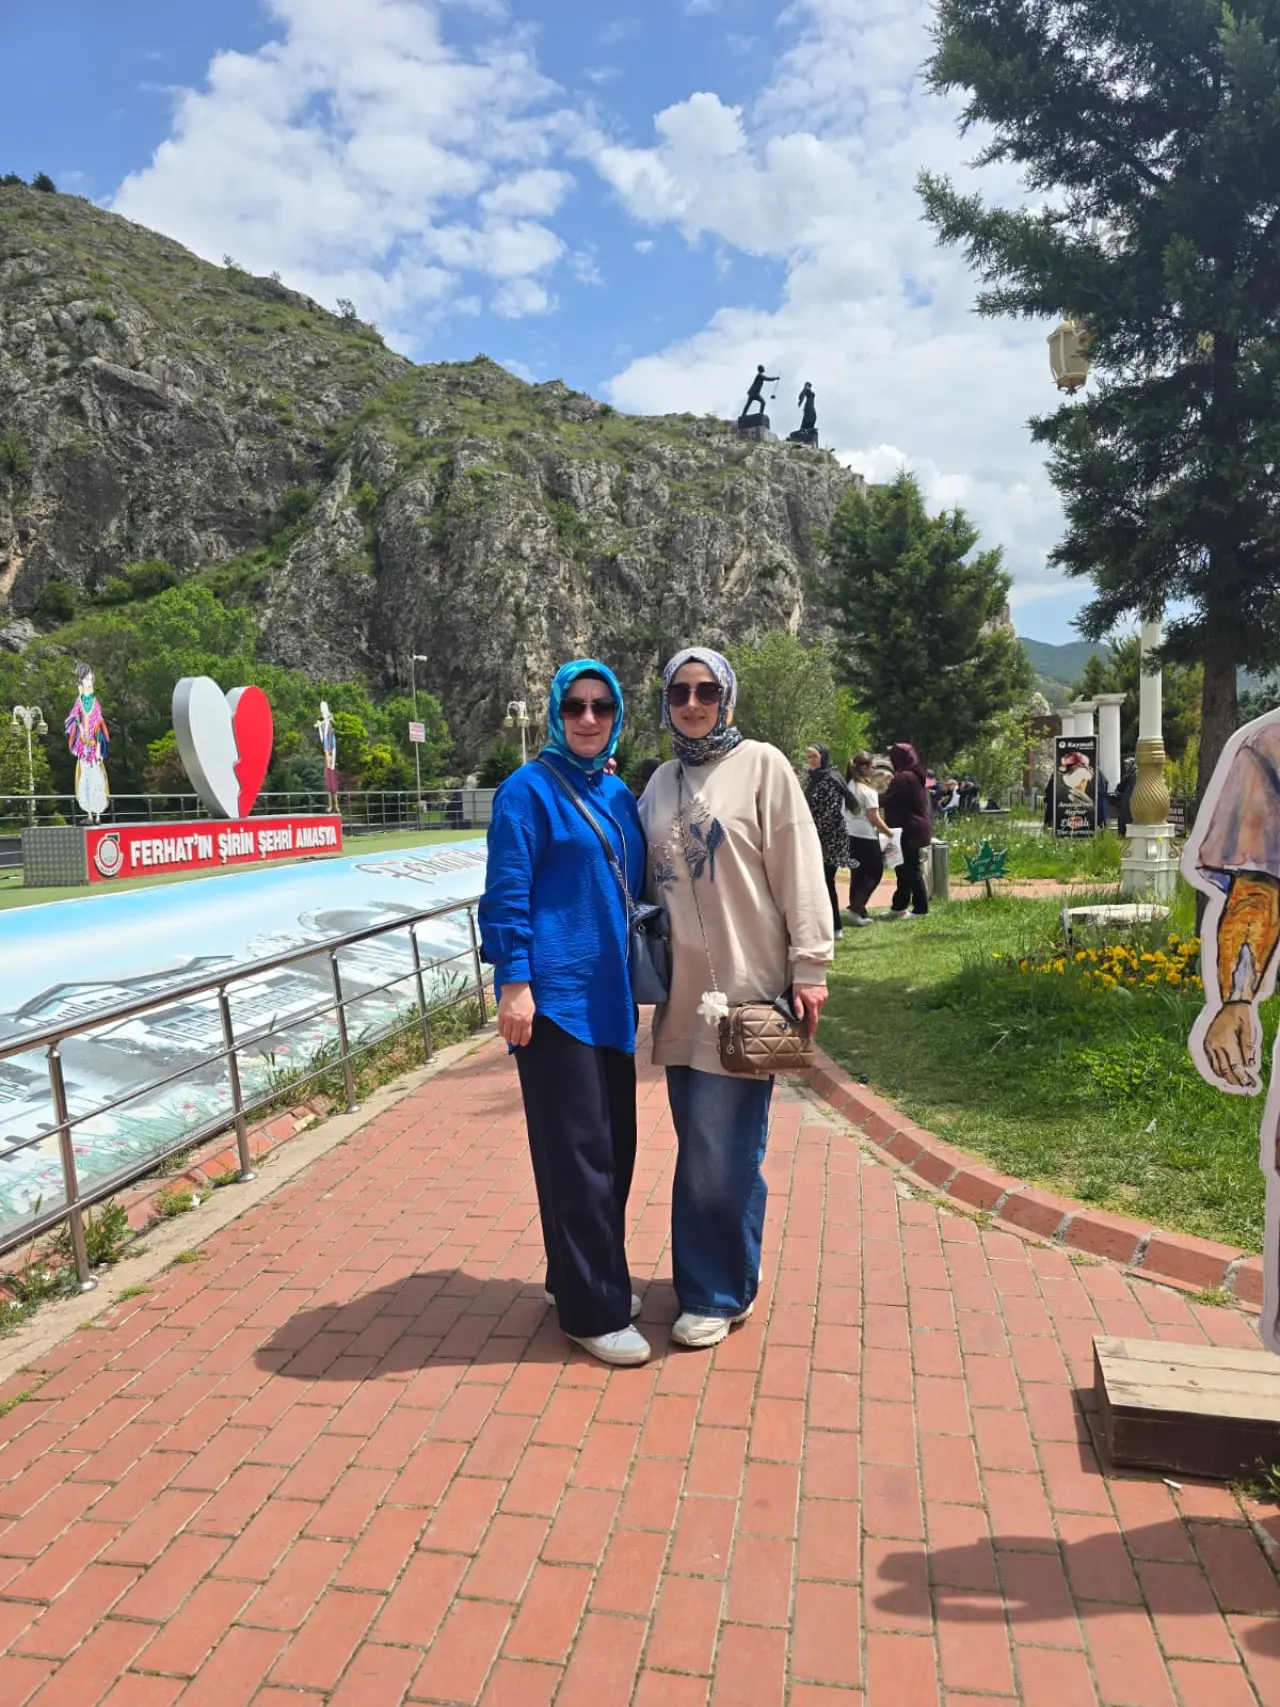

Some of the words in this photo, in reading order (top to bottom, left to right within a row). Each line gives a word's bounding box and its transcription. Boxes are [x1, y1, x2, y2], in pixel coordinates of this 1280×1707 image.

[130, 832, 213, 867] FERHAT'IN
[218, 828, 254, 864] ŞİRİN
[258, 824, 292, 859] ŞEHRİ
[296, 825, 337, 849] AMASYA
